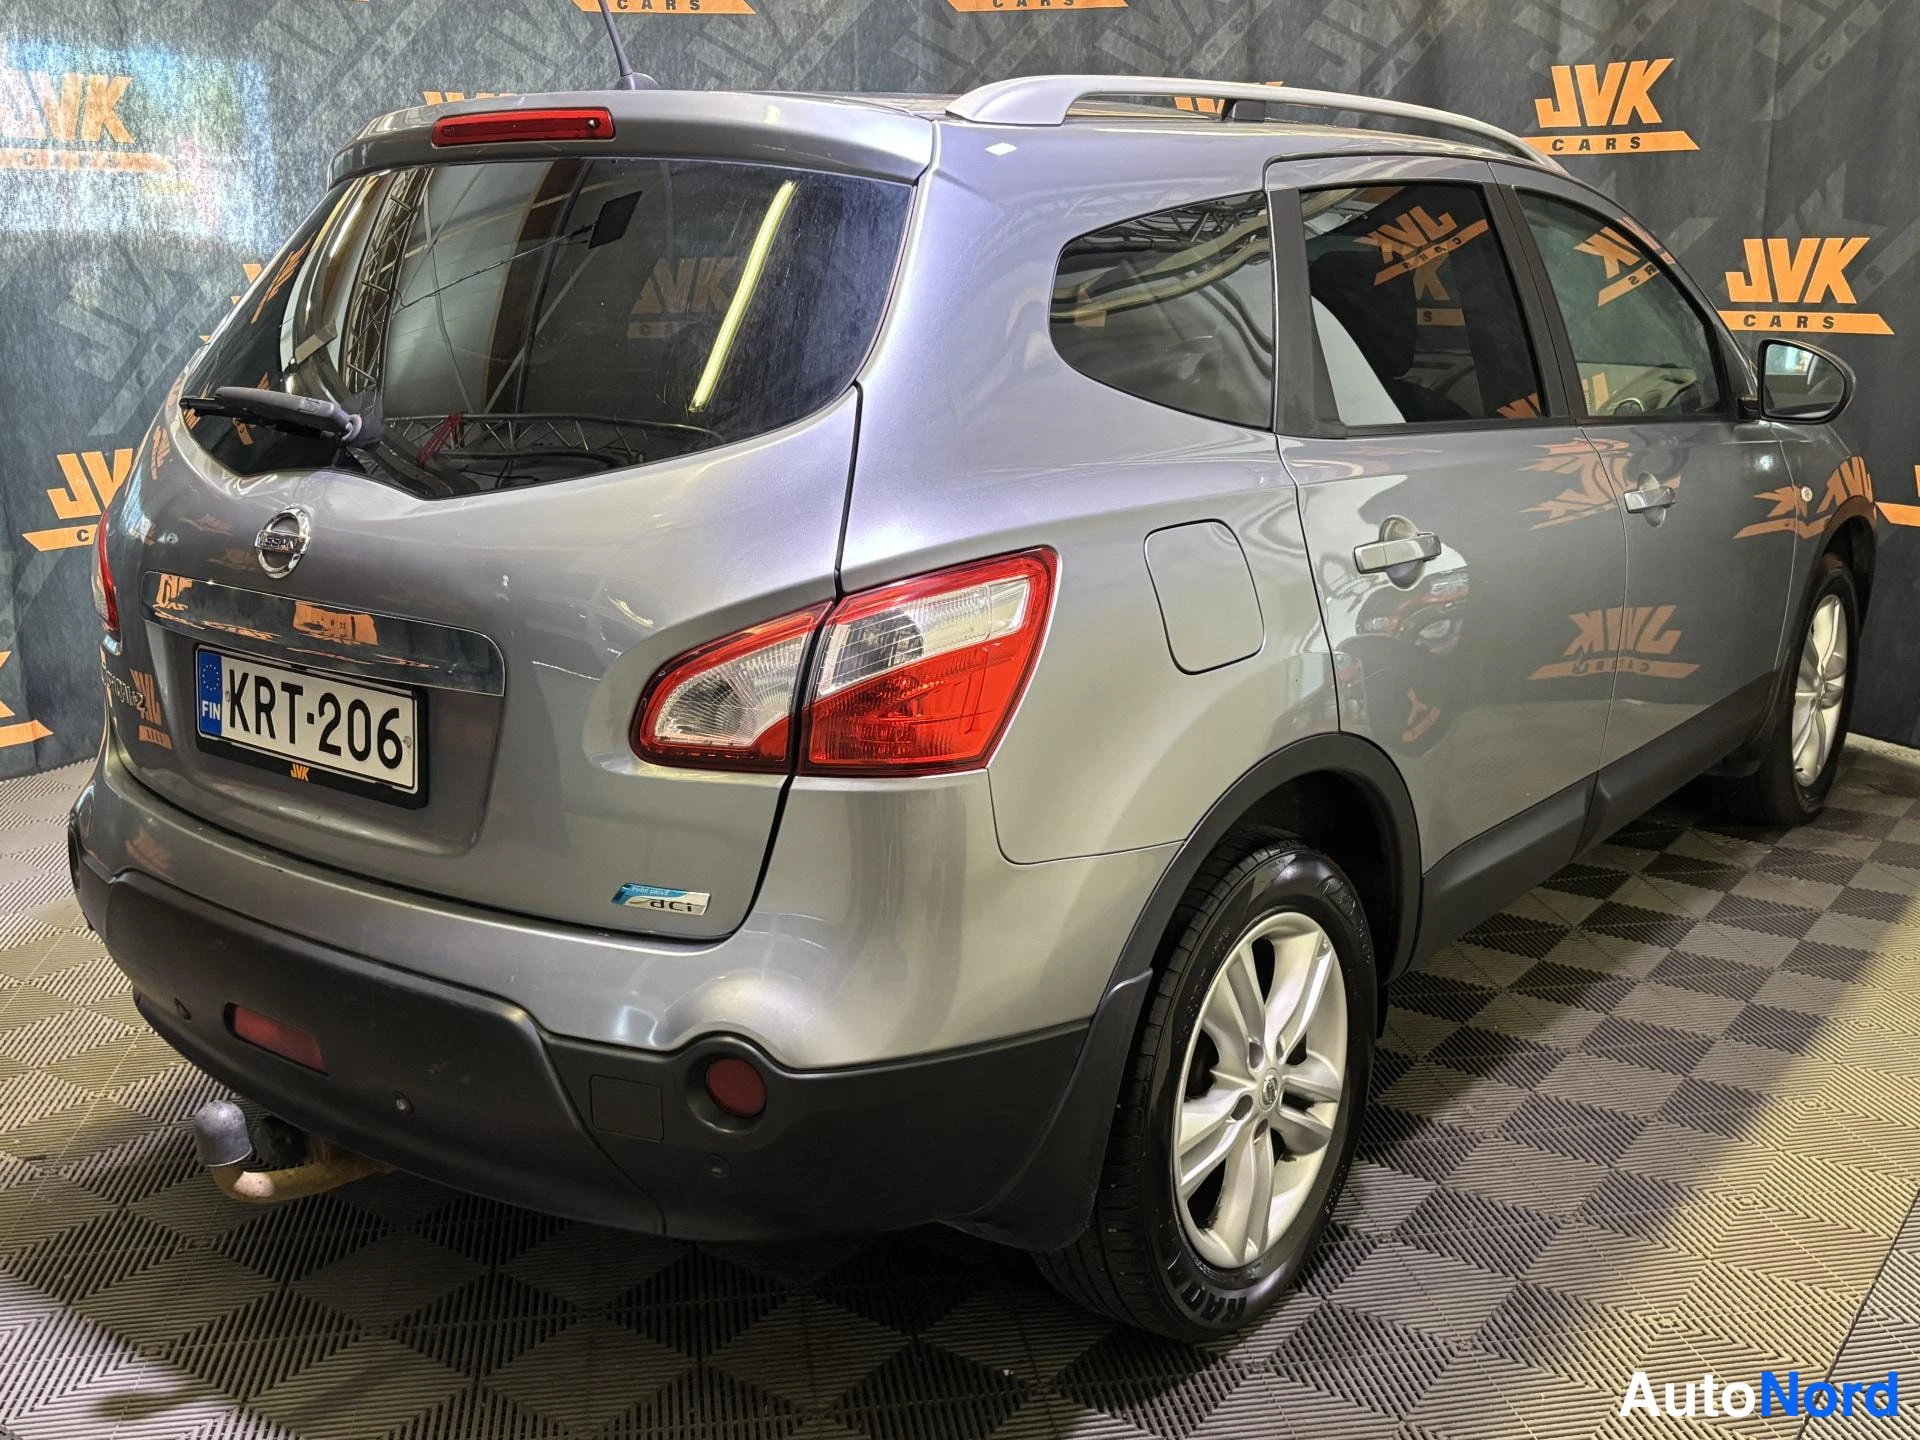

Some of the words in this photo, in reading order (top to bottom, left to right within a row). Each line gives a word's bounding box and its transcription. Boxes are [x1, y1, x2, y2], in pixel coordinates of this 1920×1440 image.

[616, 0, 702, 10] CARS
[1535, 58, 1674, 128] JVK
[1551, 136, 1641, 152] CARS
[1725, 237, 1870, 304] JVK
[1743, 314, 1834, 329] CARS
[47, 448, 133, 519] JV
[202, 700, 221, 720] FIN
[229, 669, 403, 769] KRT-206
[290, 763, 310, 782] JVK
